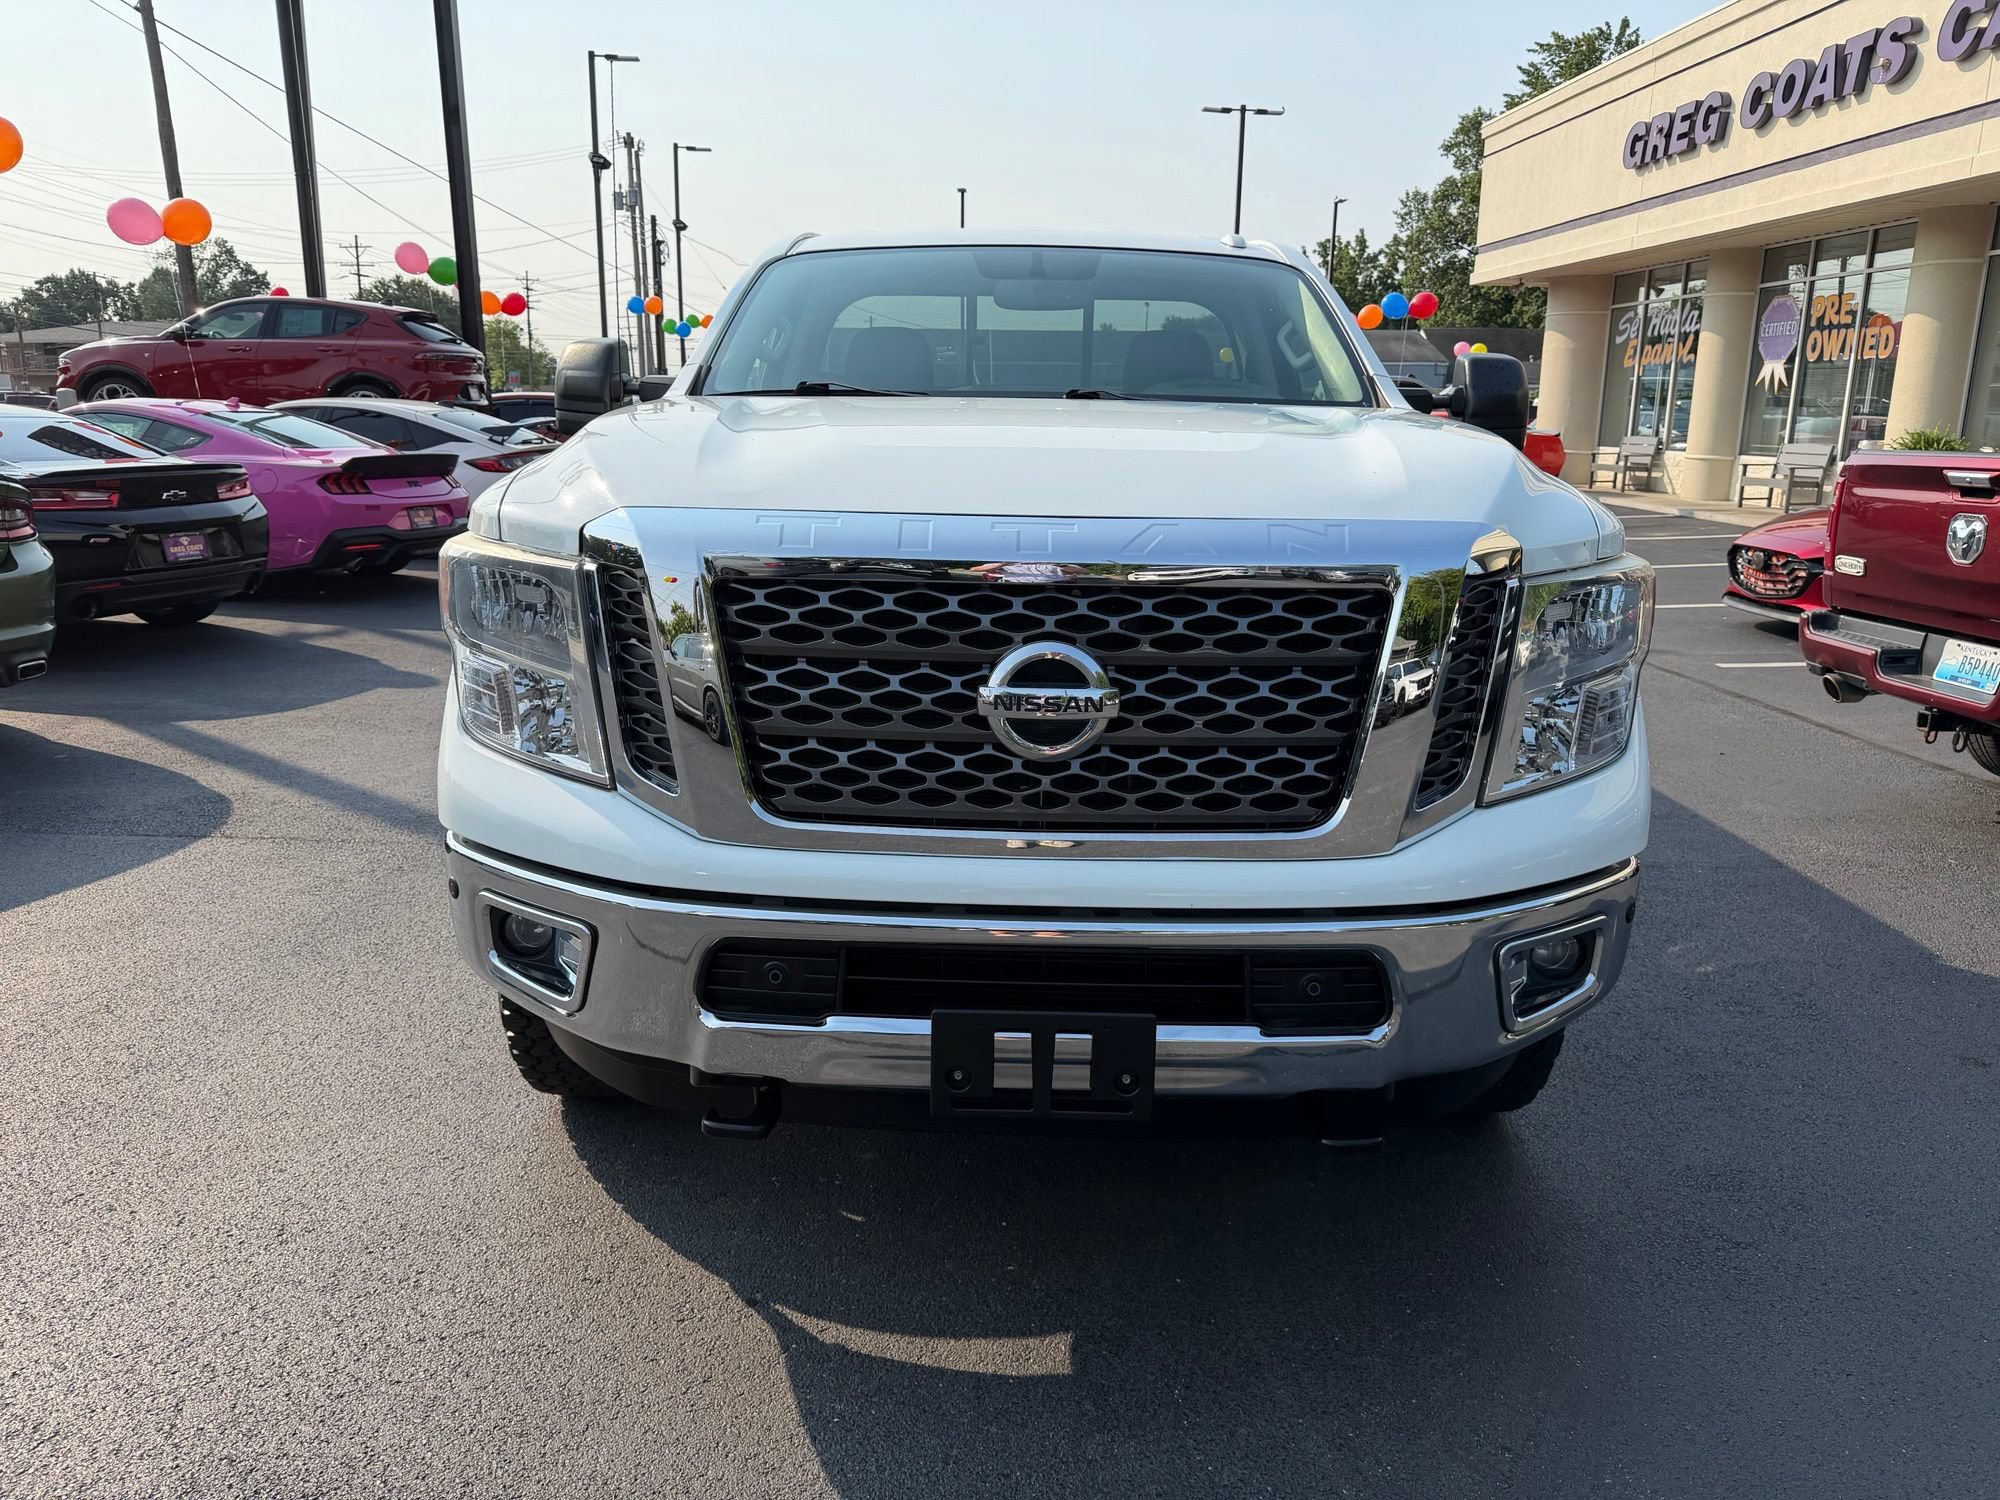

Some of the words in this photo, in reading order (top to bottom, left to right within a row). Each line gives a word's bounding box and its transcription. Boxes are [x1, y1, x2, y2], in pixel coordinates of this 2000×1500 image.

[1623, 91, 1731, 170] GREG
[1740, 16, 1923, 129] COATS
[1615, 310, 1640, 345] Se
[1760, 320, 1797, 338] CERTIFIED
[1806, 325, 1895, 362] OWNED
[755, 514, 1348, 556] TITAN
[1960, 644, 1994, 657] KENTUCKY
[993, 694, 1104, 713] NISSAN
